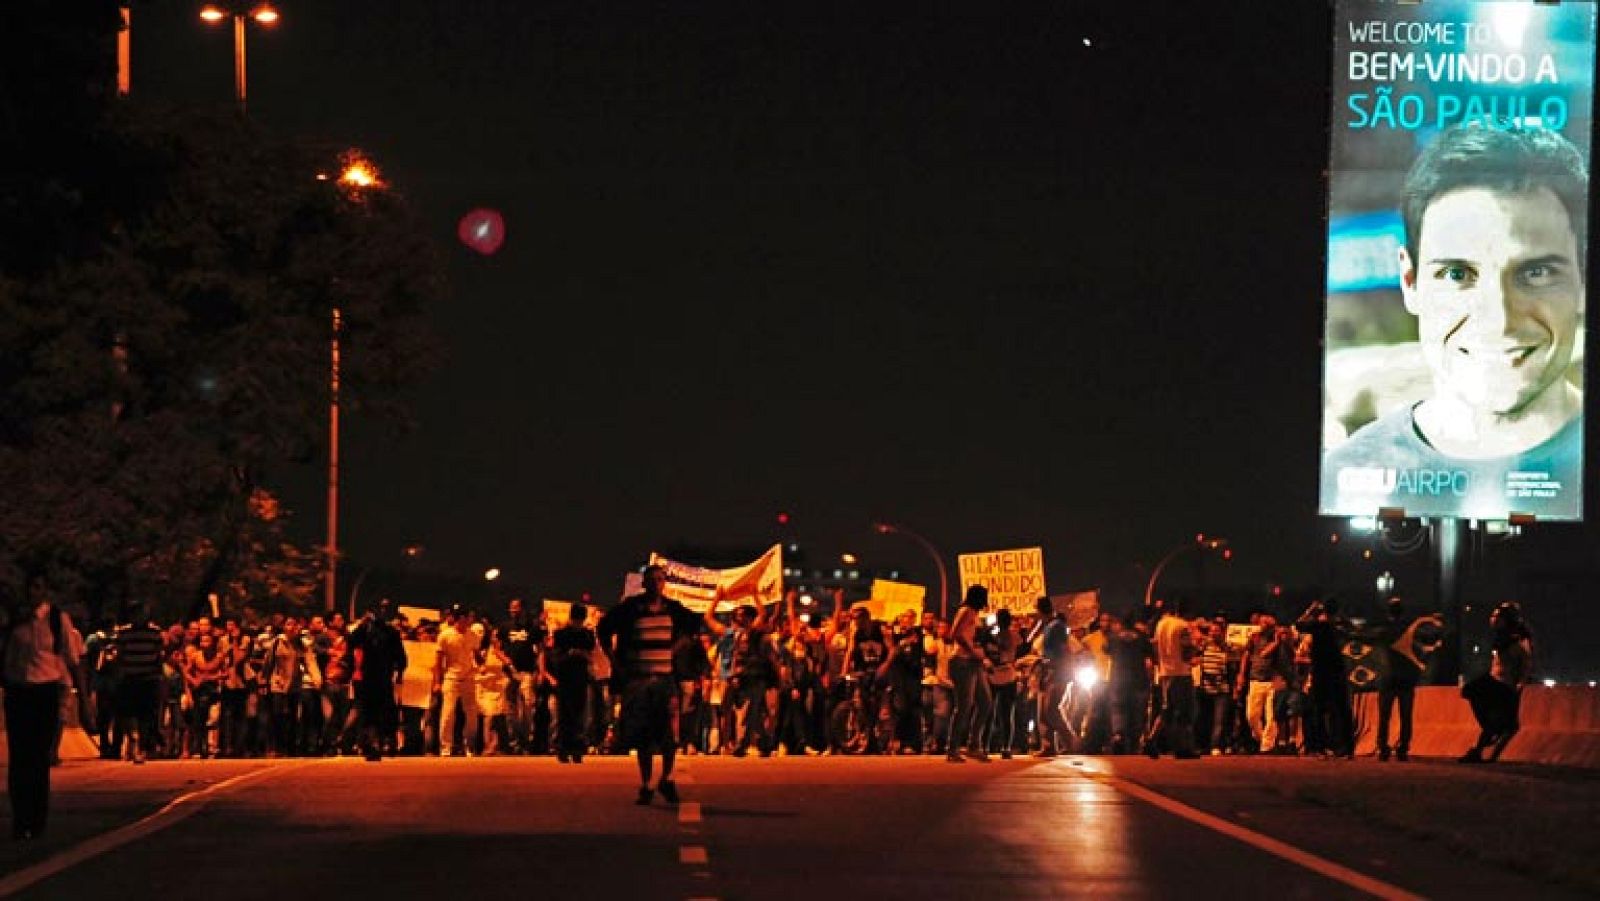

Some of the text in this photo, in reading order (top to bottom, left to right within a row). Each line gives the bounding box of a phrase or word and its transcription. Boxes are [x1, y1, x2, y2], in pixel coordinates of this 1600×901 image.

[1349, 21, 1490, 44] WELCOME TO
[1349, 51, 1559, 84] BEM-VINDO A
[1347, 86, 1568, 132] SÃO PAULO
